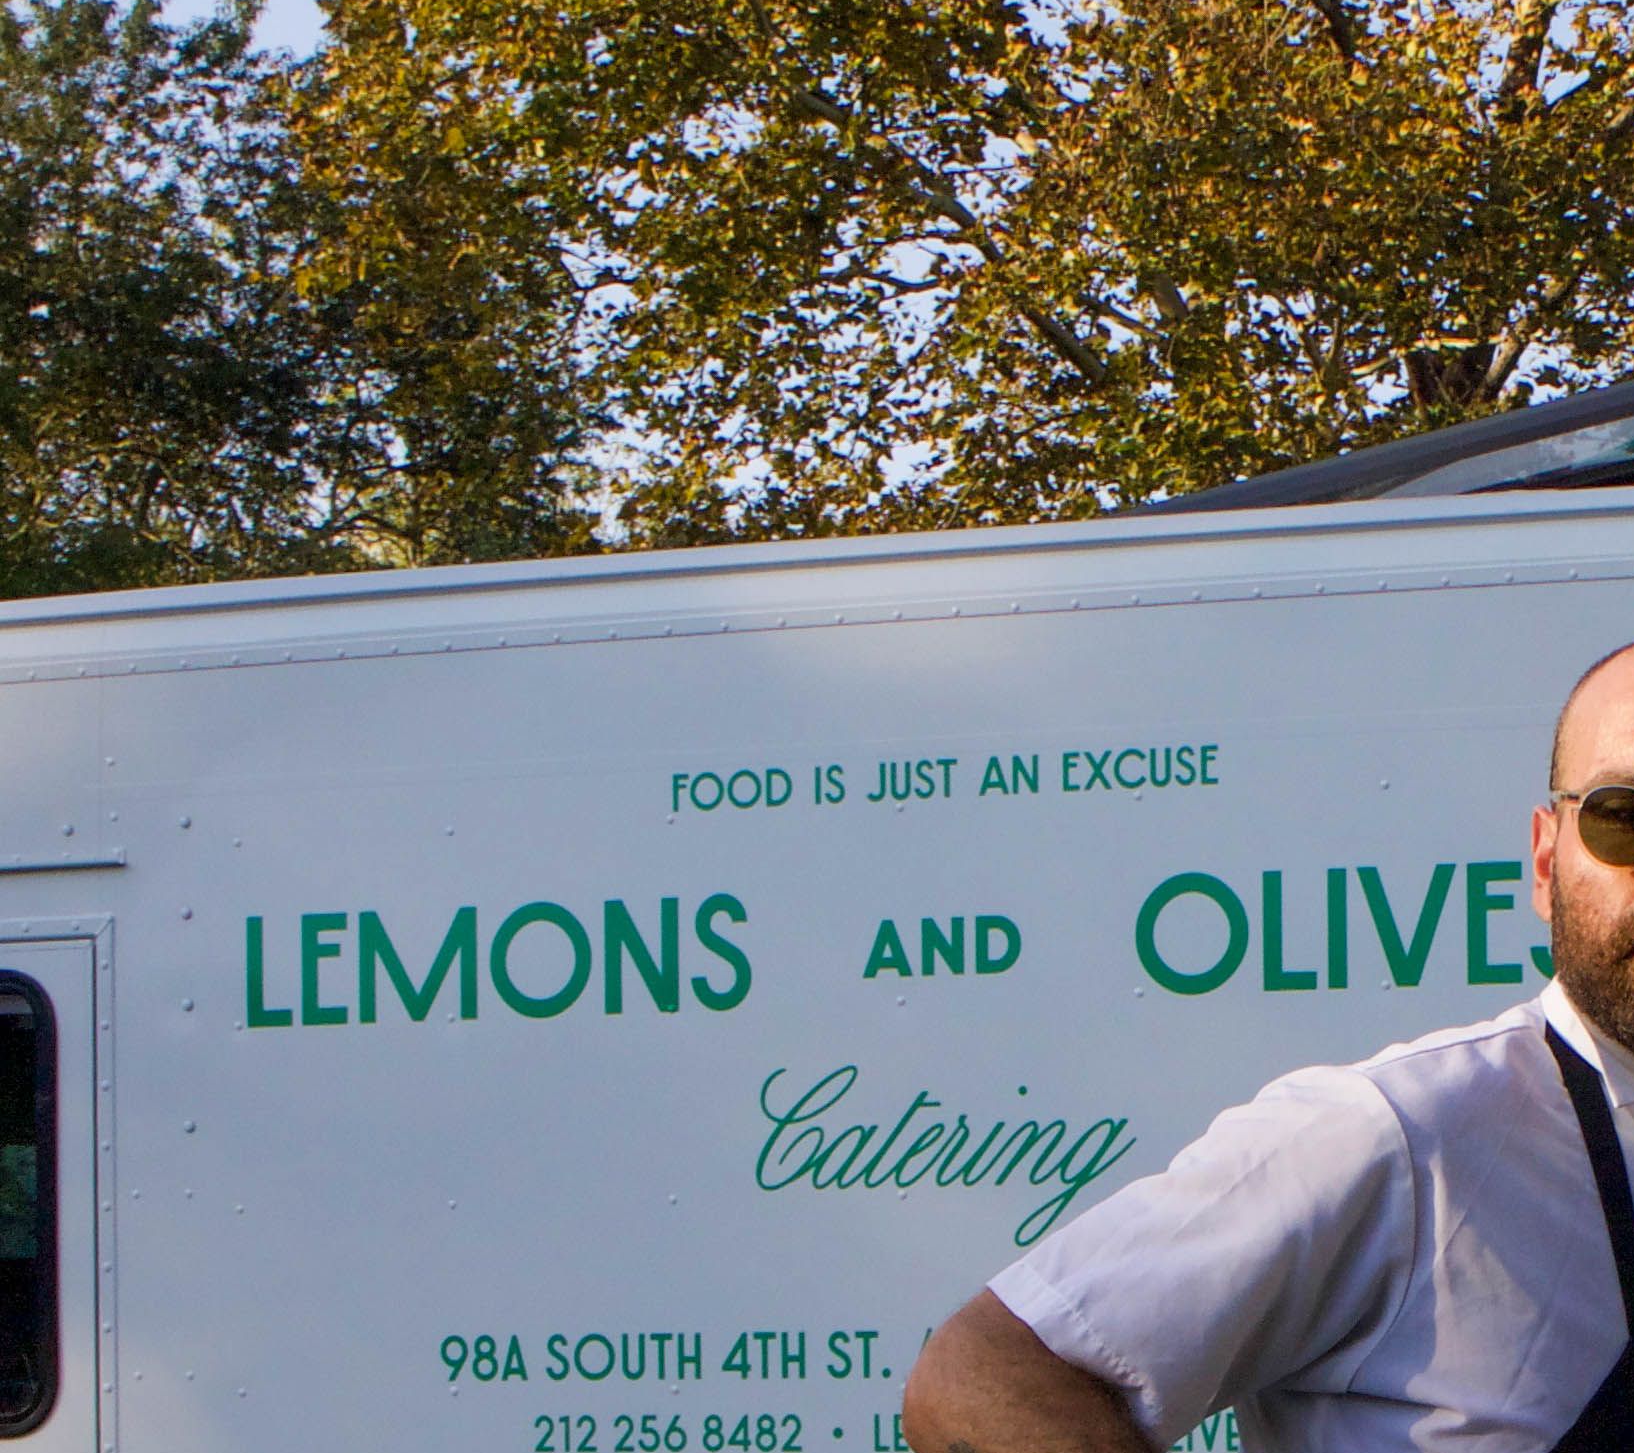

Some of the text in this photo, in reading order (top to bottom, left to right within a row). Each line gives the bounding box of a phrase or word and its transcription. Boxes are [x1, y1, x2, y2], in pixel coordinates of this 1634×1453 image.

[672, 744, 1219, 812] FOOD IS JUST AN EXCUSE
[245, 891, 753, 1028] LEMONS
[863, 914, 1022, 978] AND
[754, 1063, 1136, 1247] Catering
[440, 1333, 529, 1382] 98A
[545, 1331, 702, 1381] SOUTH
[721, 1330, 806, 1380] 4TH
[826, 1330, 892, 1379] ST.
[533, 1413, 803, 1453] 212 256 8482
